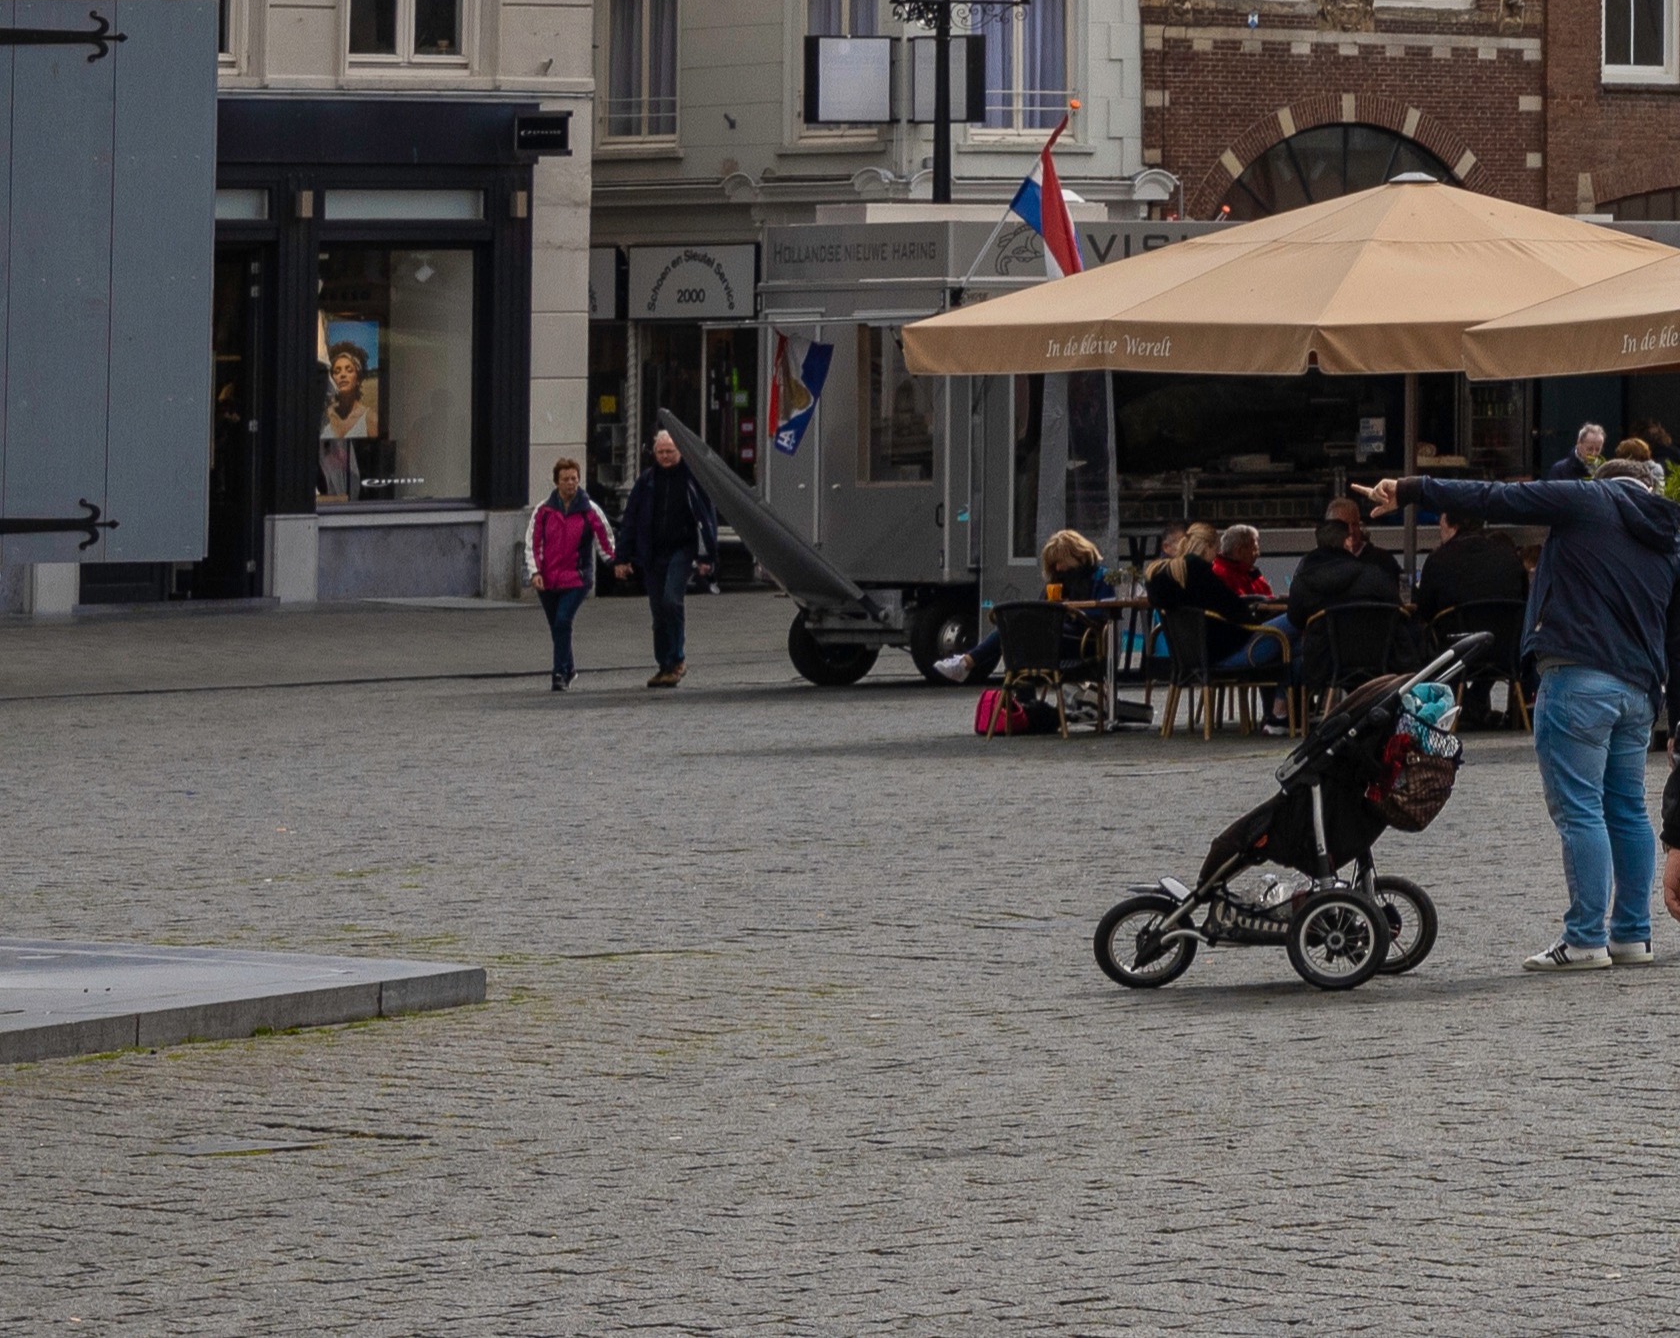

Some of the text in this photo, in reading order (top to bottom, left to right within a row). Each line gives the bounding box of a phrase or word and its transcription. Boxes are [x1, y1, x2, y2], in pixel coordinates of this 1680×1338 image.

[774, 242, 936, 263] HOLLANDSE NIEUWE HARING
[647, 249, 736, 312] Schoen en Sleutel Service
[676, 288, 706, 304] 2000
[1046, 333, 1172, 358] In de kleine Werelt
[1621, 334, 1637, 354] In
[1640, 329, 1656, 351] de
